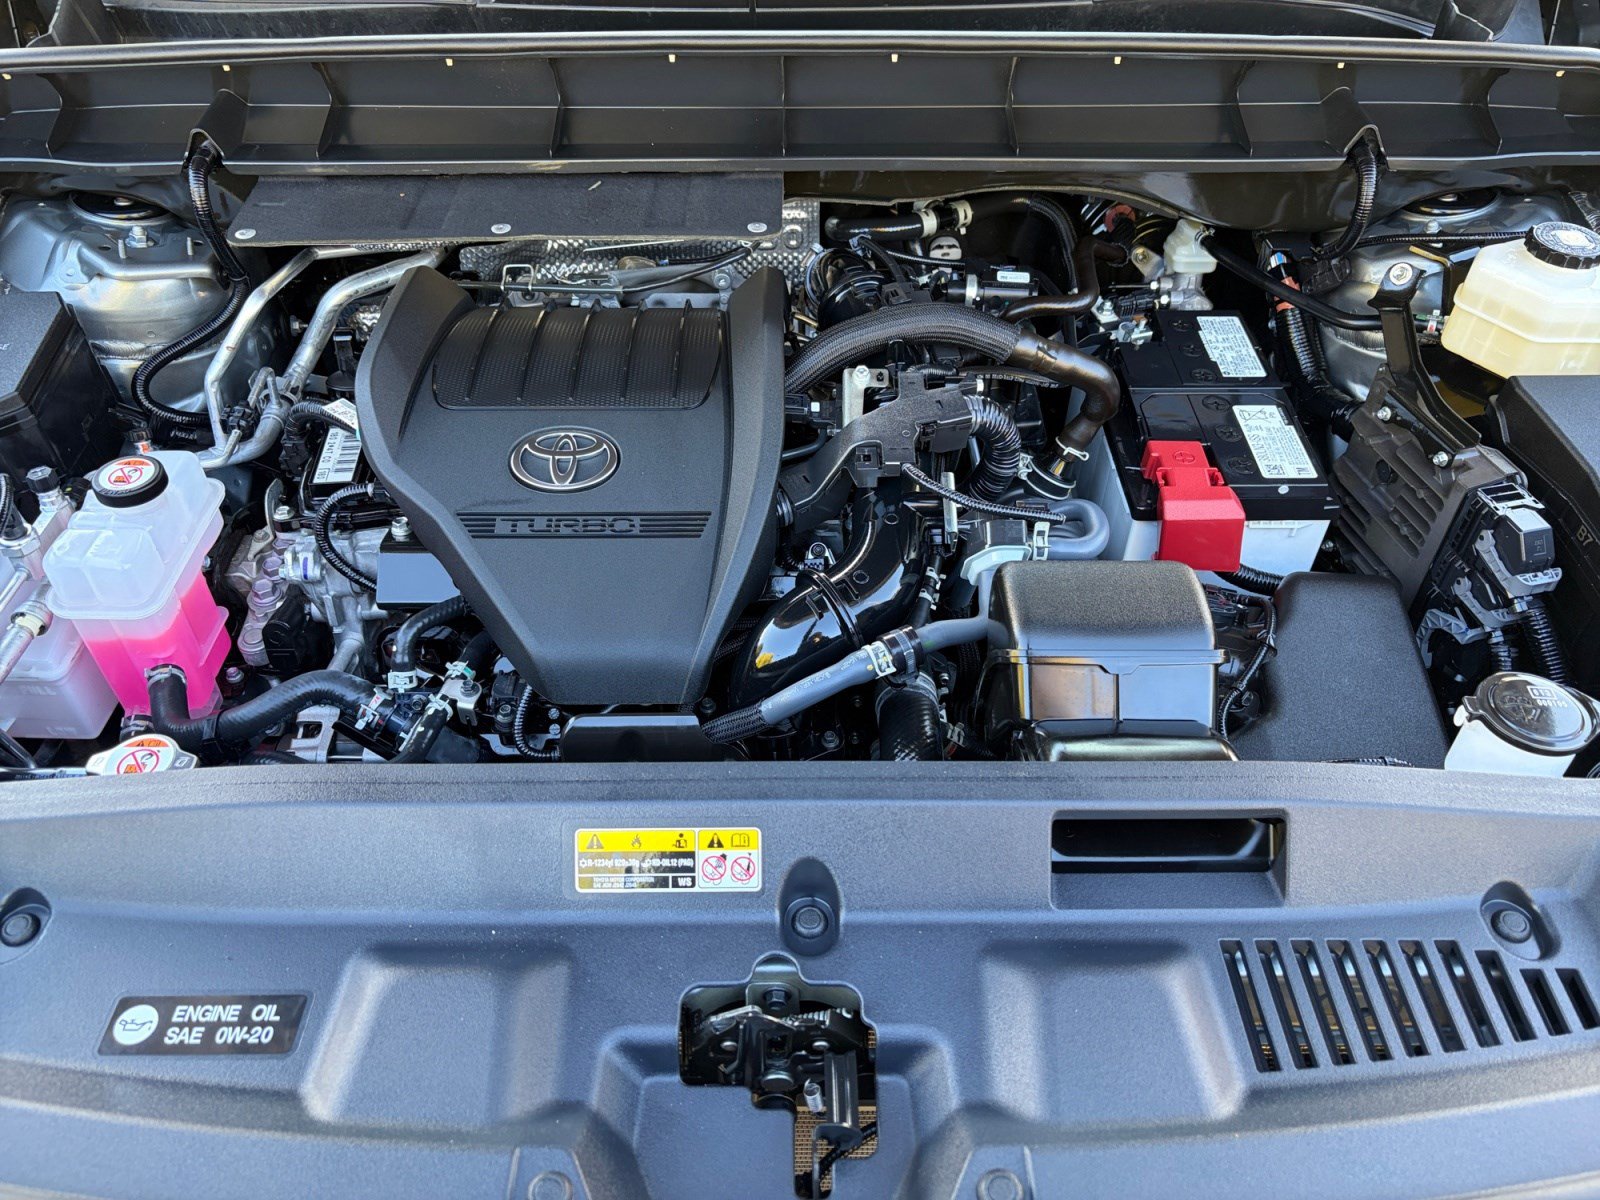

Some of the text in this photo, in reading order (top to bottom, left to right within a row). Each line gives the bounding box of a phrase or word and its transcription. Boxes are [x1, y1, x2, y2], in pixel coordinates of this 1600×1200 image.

[500, 517, 636, 534] TURBO
[1576, 524, 1594, 546] B7
[677, 877, 692, 887] WS
[171, 1004, 281, 1023] ENGINE OIL
[163, 1026, 275, 1045] SAE 0W-20
